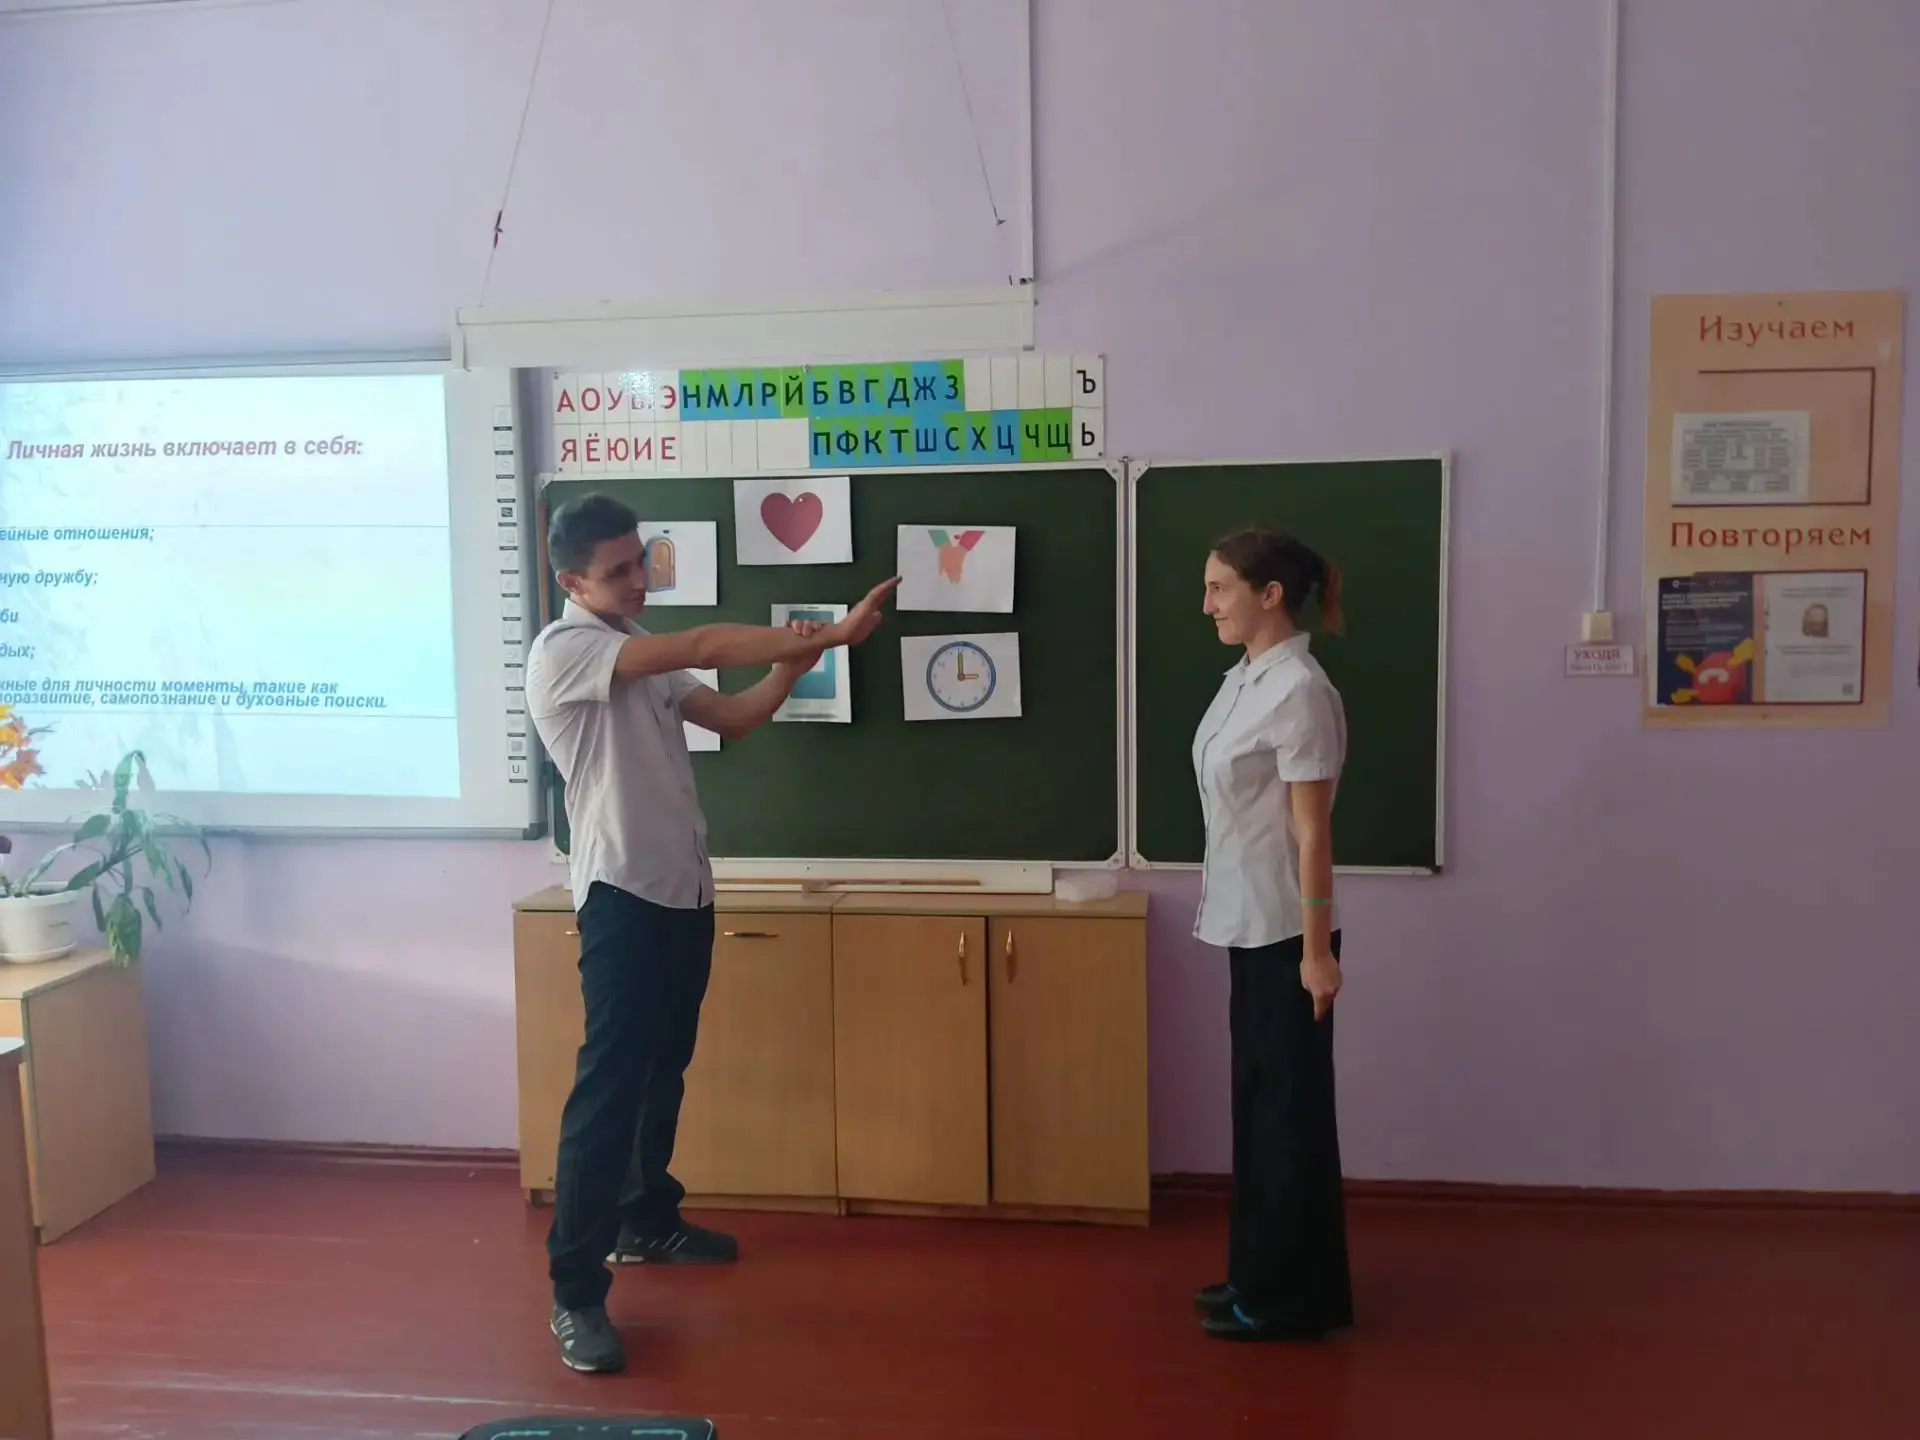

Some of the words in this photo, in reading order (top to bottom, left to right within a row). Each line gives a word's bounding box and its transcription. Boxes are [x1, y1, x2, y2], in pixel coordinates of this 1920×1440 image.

[1699, 314, 1855, 347] Изучаем
[6, 440, 84, 460] Личная
[90, 441, 156, 458] жизнь
[164, 439, 277, 458] включает
[284, 440, 296, 456] в
[304, 435, 365, 456] себя:
[54, 526, 155, 543] отношения;
[1670, 520, 1871, 555] Повторяем
[35, 569, 98, 588] дружбу;
[42, 676, 70, 692] для
[74, 680, 156, 692] личности
[161, 680, 247, 694] моменты,
[253, 681, 306, 694] такие
[311, 682, 339, 694] как
[100, 692, 217, 706] самопознание
[221, 694, 231, 706] и
[236, 691, 320, 709] духовные
